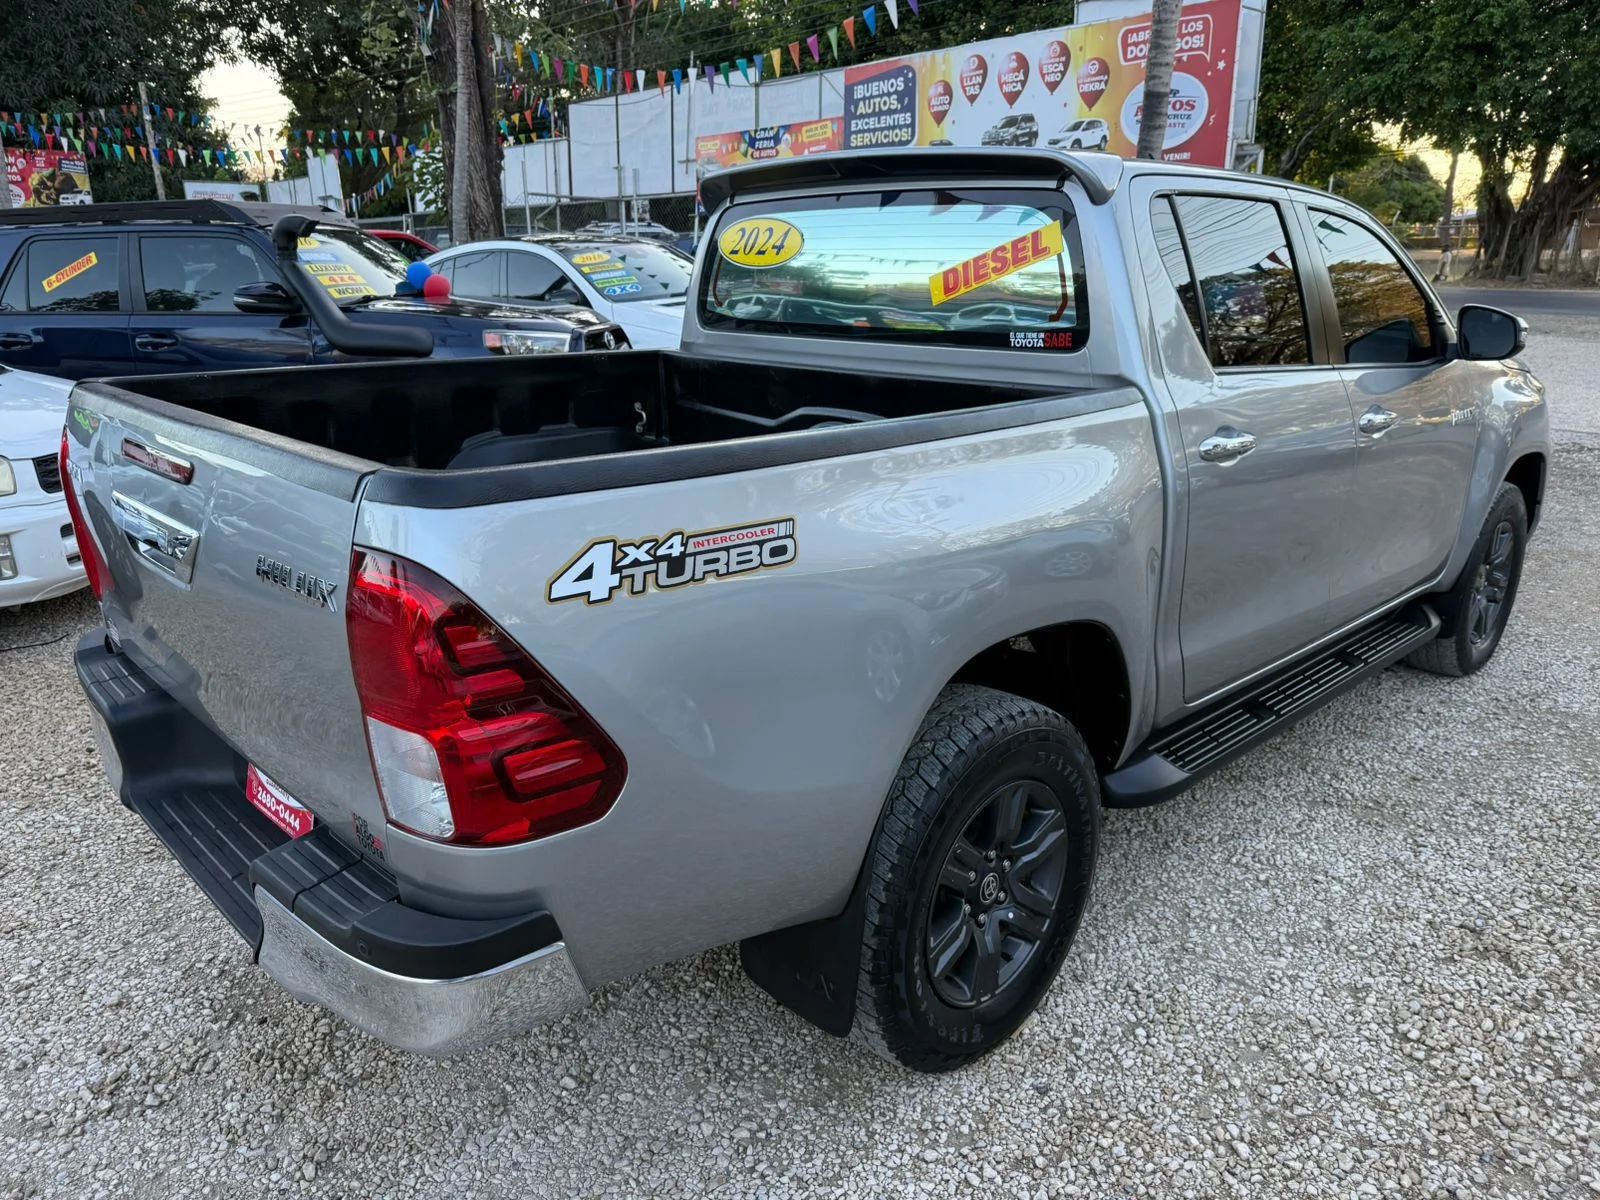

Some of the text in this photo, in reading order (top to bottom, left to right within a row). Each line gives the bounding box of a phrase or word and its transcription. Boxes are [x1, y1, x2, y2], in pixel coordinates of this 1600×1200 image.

[1182, 21, 1203, 34] LOS
[1043, 62, 1065, 74] ESCA
[963, 75, 983, 87] LLAN
[1001, 69, 1025, 82] MECÁ
[1045, 72, 1061, 83] NEO
[853, 77, 905, 100] ¡BUENOS
[965, 84, 980, 96] TAS
[1002, 81, 1022, 93] NICA
[1079, 81, 1106, 93] DEKRA
[856, 94, 901, 116] AUTOS,
[930, 95, 950, 107] AUTO
[850, 112, 912, 131] EXCELENTES
[1167, 113, 1192, 121] CRUZ
[755, 129, 774, 139] GRAN
[850, 127, 912, 147] SERVICIOS!
[755, 139, 775, 149] FERIA
[760, 149, 777, 158] AUTOS
[1163, 152, 1191, 161] VENIR!
[728, 226, 792, 256] 2024
[308, 263, 350, 273] LUXURY
[942, 230, 1051, 298] DIESEL
[46, 255, 94, 289] 6-CYLINDER
[605, 284, 640, 295] 4X4
[1010, 332, 1073, 348] TOYOTA SABE
[693, 527, 776, 549] INTERCOOLER
[622, 537, 796, 593] TURBO
[257, 785, 300, 832] 2680-0444
